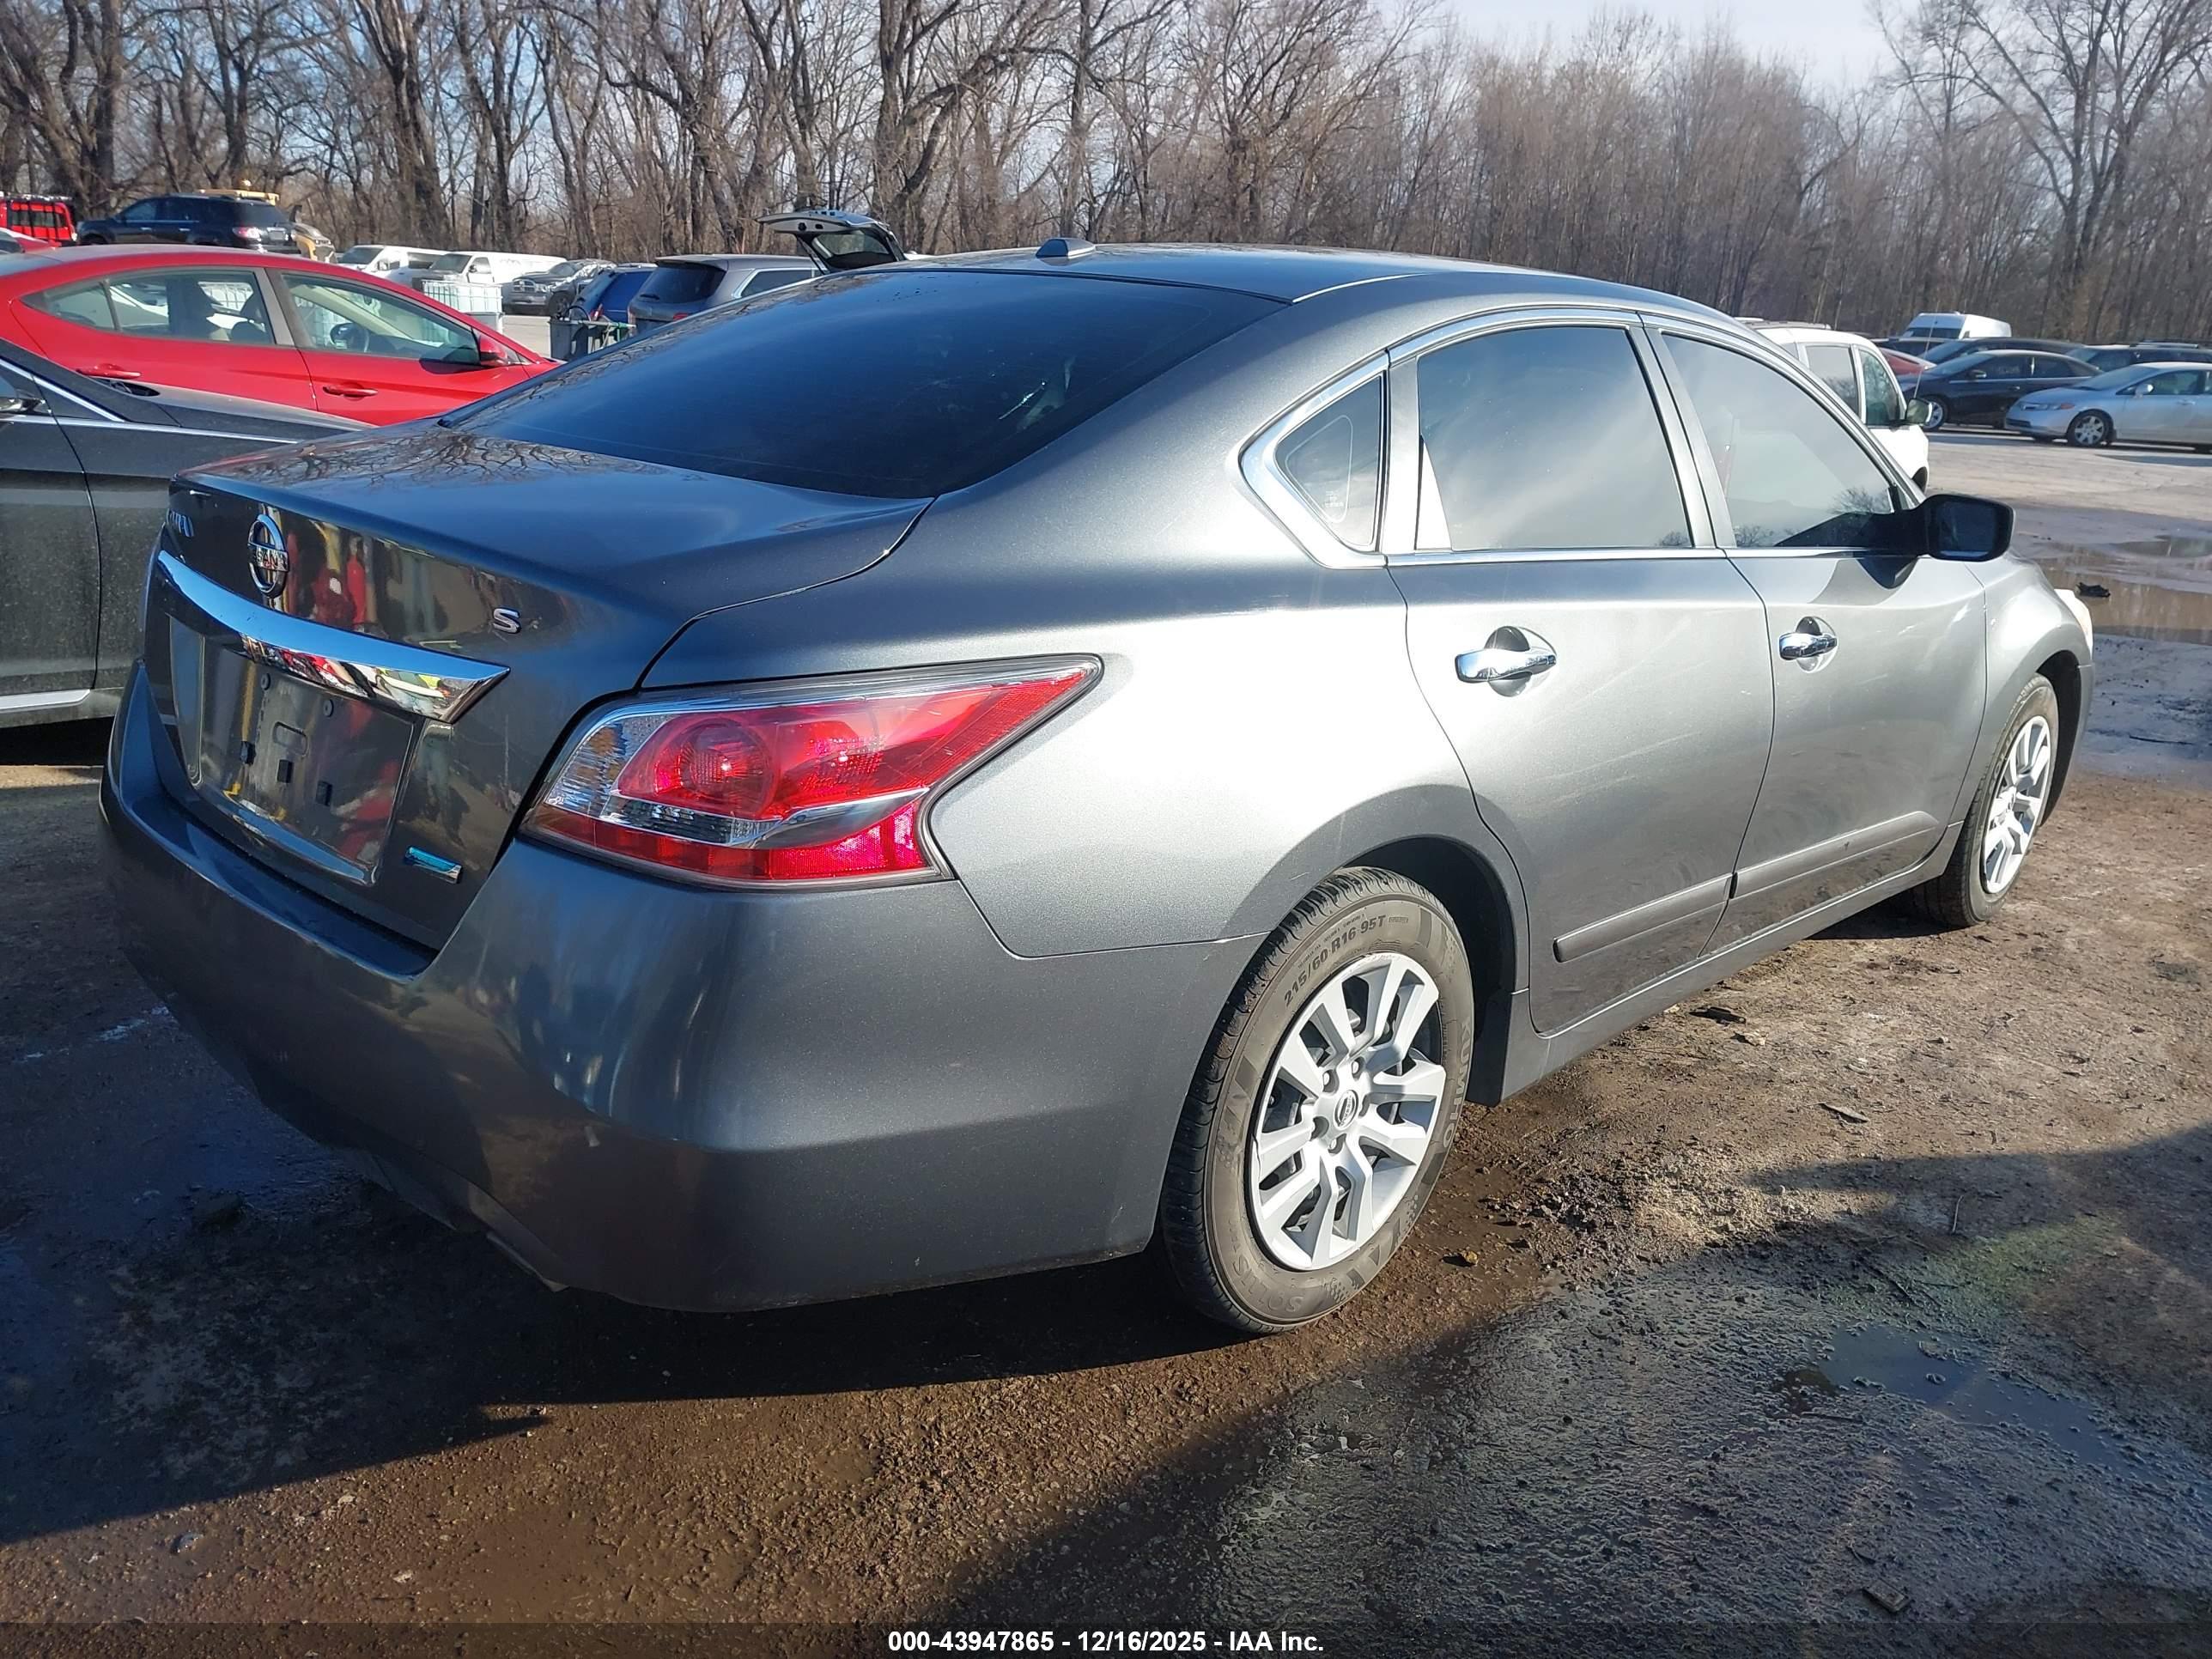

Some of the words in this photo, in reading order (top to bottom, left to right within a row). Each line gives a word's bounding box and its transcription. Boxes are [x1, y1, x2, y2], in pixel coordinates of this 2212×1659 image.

[493, 607, 520, 634] S
[1285, 949, 1328, 1006] 215/60
[1332, 927, 1358, 953] R16
[1360, 915, 1386, 934] 95T
[1443, 1017, 1471, 1148] KUMHO
